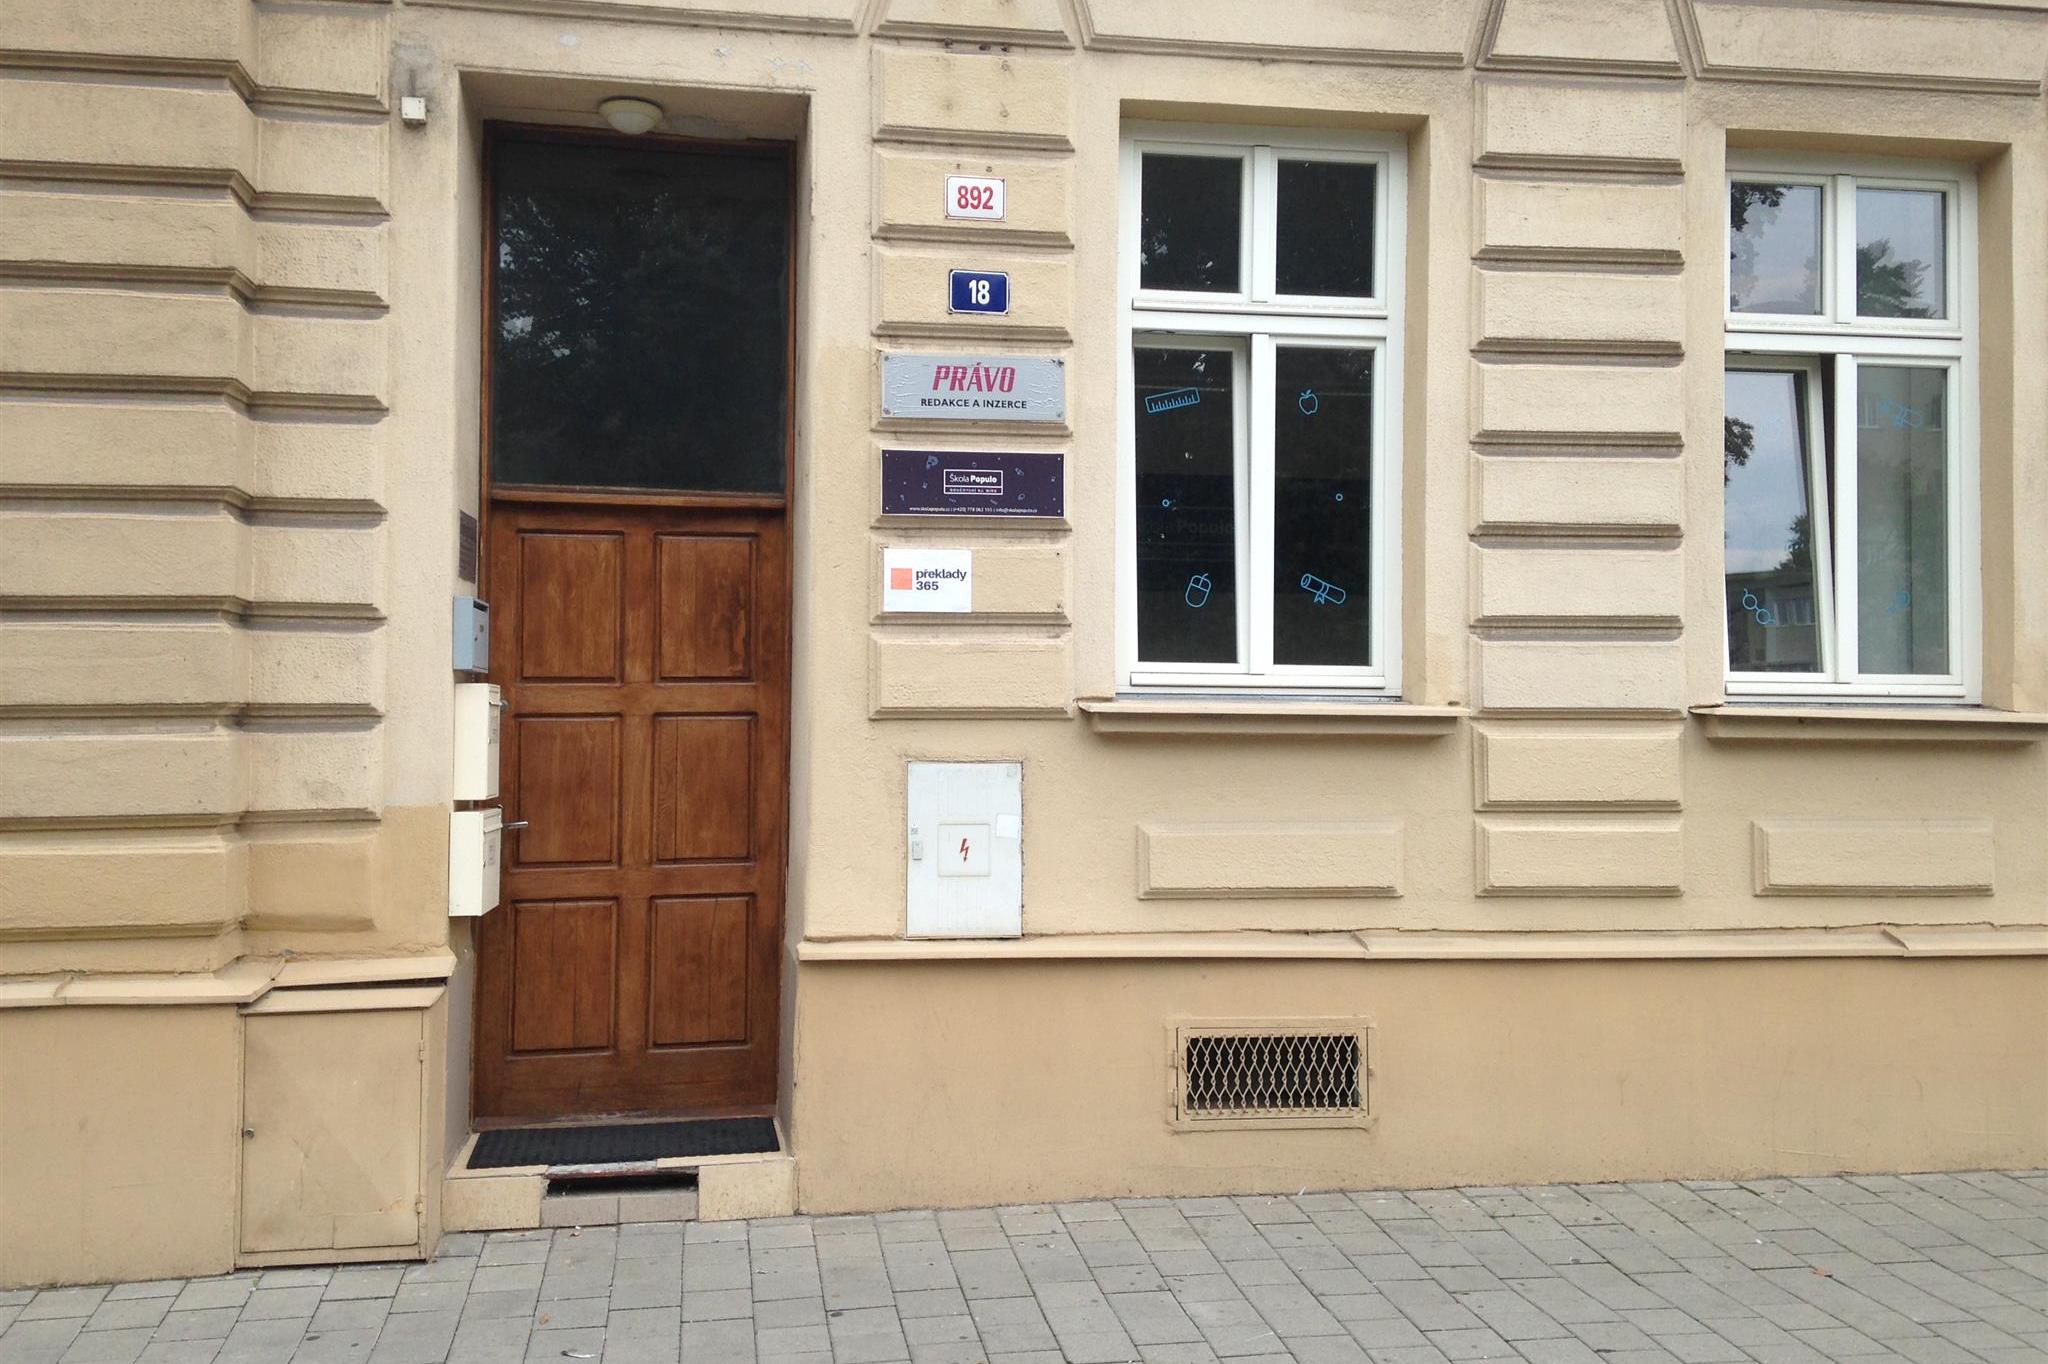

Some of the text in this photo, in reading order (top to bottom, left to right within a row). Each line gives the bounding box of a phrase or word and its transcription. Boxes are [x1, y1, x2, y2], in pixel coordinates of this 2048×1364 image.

[957, 185, 994, 210] 892
[968, 279, 990, 305] 18
[932, 362, 1016, 393] PRÁVO
[921, 398, 1027, 409] REDAKCE A INZERCE
[949, 473, 998, 485] Škola Populo
[915, 568, 967, 582] překlady
[915, 581, 939, 591] 365
